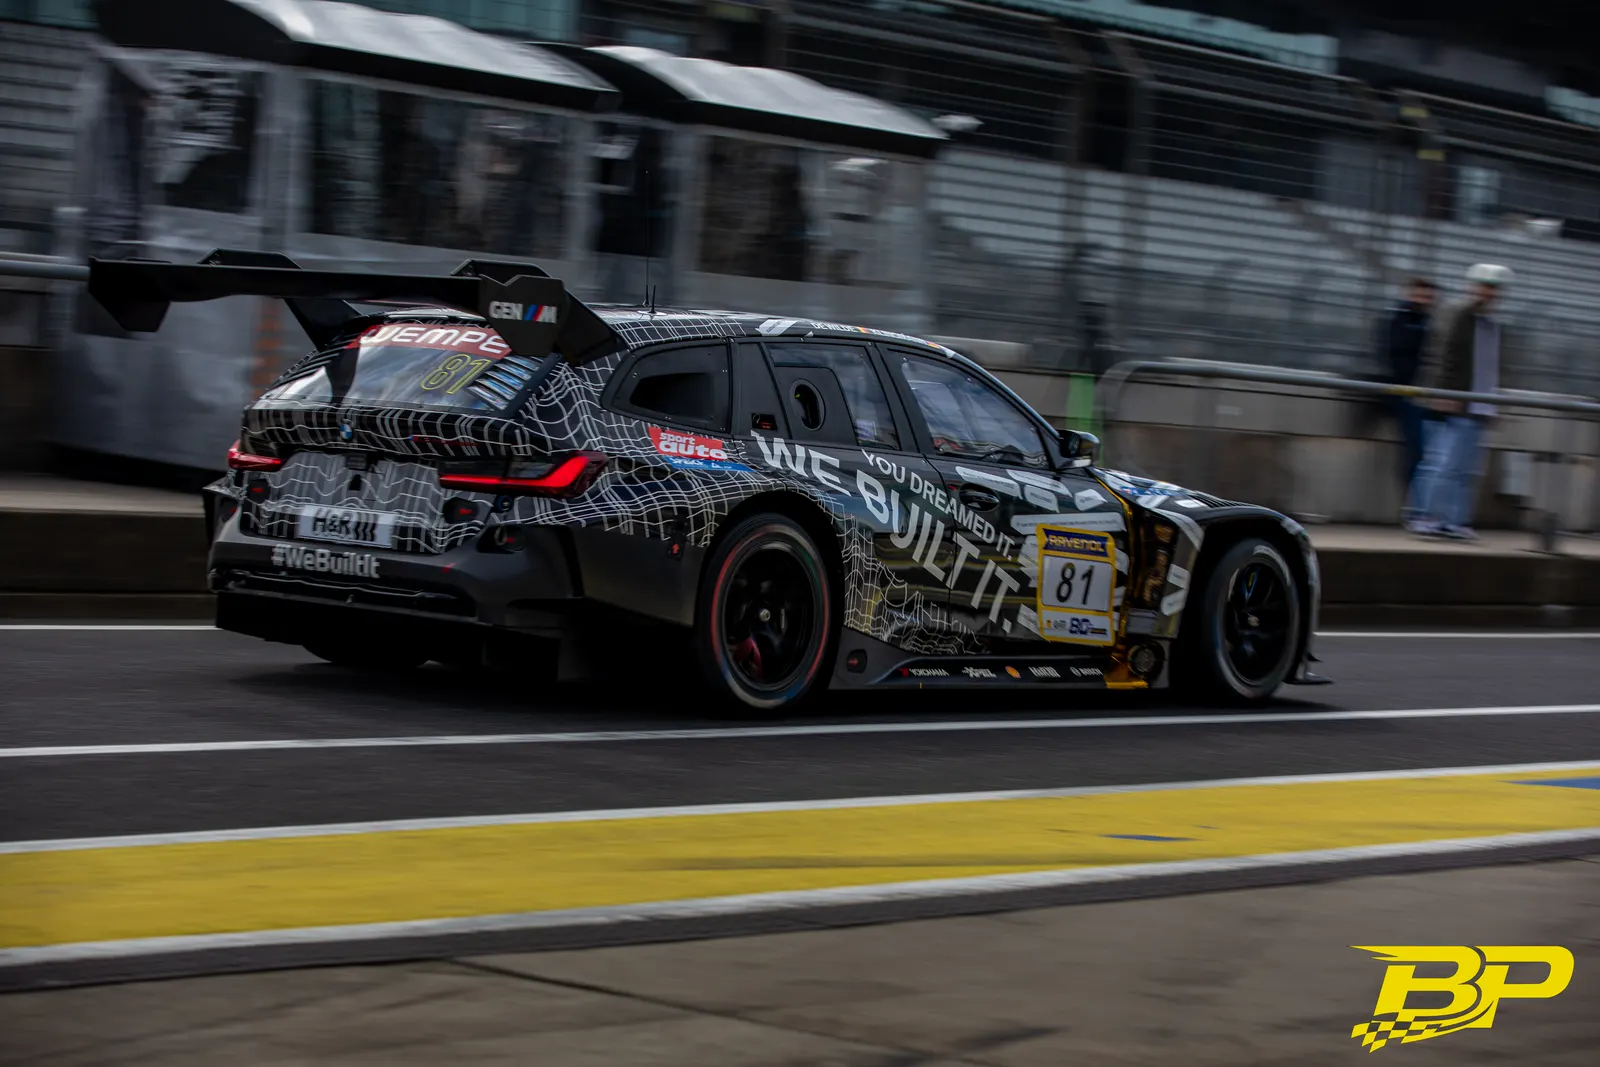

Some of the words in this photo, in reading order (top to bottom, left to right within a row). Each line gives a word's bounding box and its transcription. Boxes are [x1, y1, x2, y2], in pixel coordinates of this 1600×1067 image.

[489, 301, 523, 320] GEN
[359, 326, 510, 354] WEMPE
[420, 353, 492, 395] 81
[659, 432, 695, 445] sport
[659, 440, 728, 460] auto
[861, 449, 906, 484] YOU
[909, 471, 996, 544] DREAMED
[995, 531, 1016, 561] IT.
[313, 507, 352, 537] H&R
[751, 429, 852, 497] WE
[856, 469, 981, 590] BUILT
[970, 558, 1021, 634] IT.
[1048, 534, 1105, 553] RAVENOL
[271, 543, 380, 578] #WeBuiltIt
[1056, 562, 1095, 606] 81
[908, 668, 950, 677] YOKOHAMA
